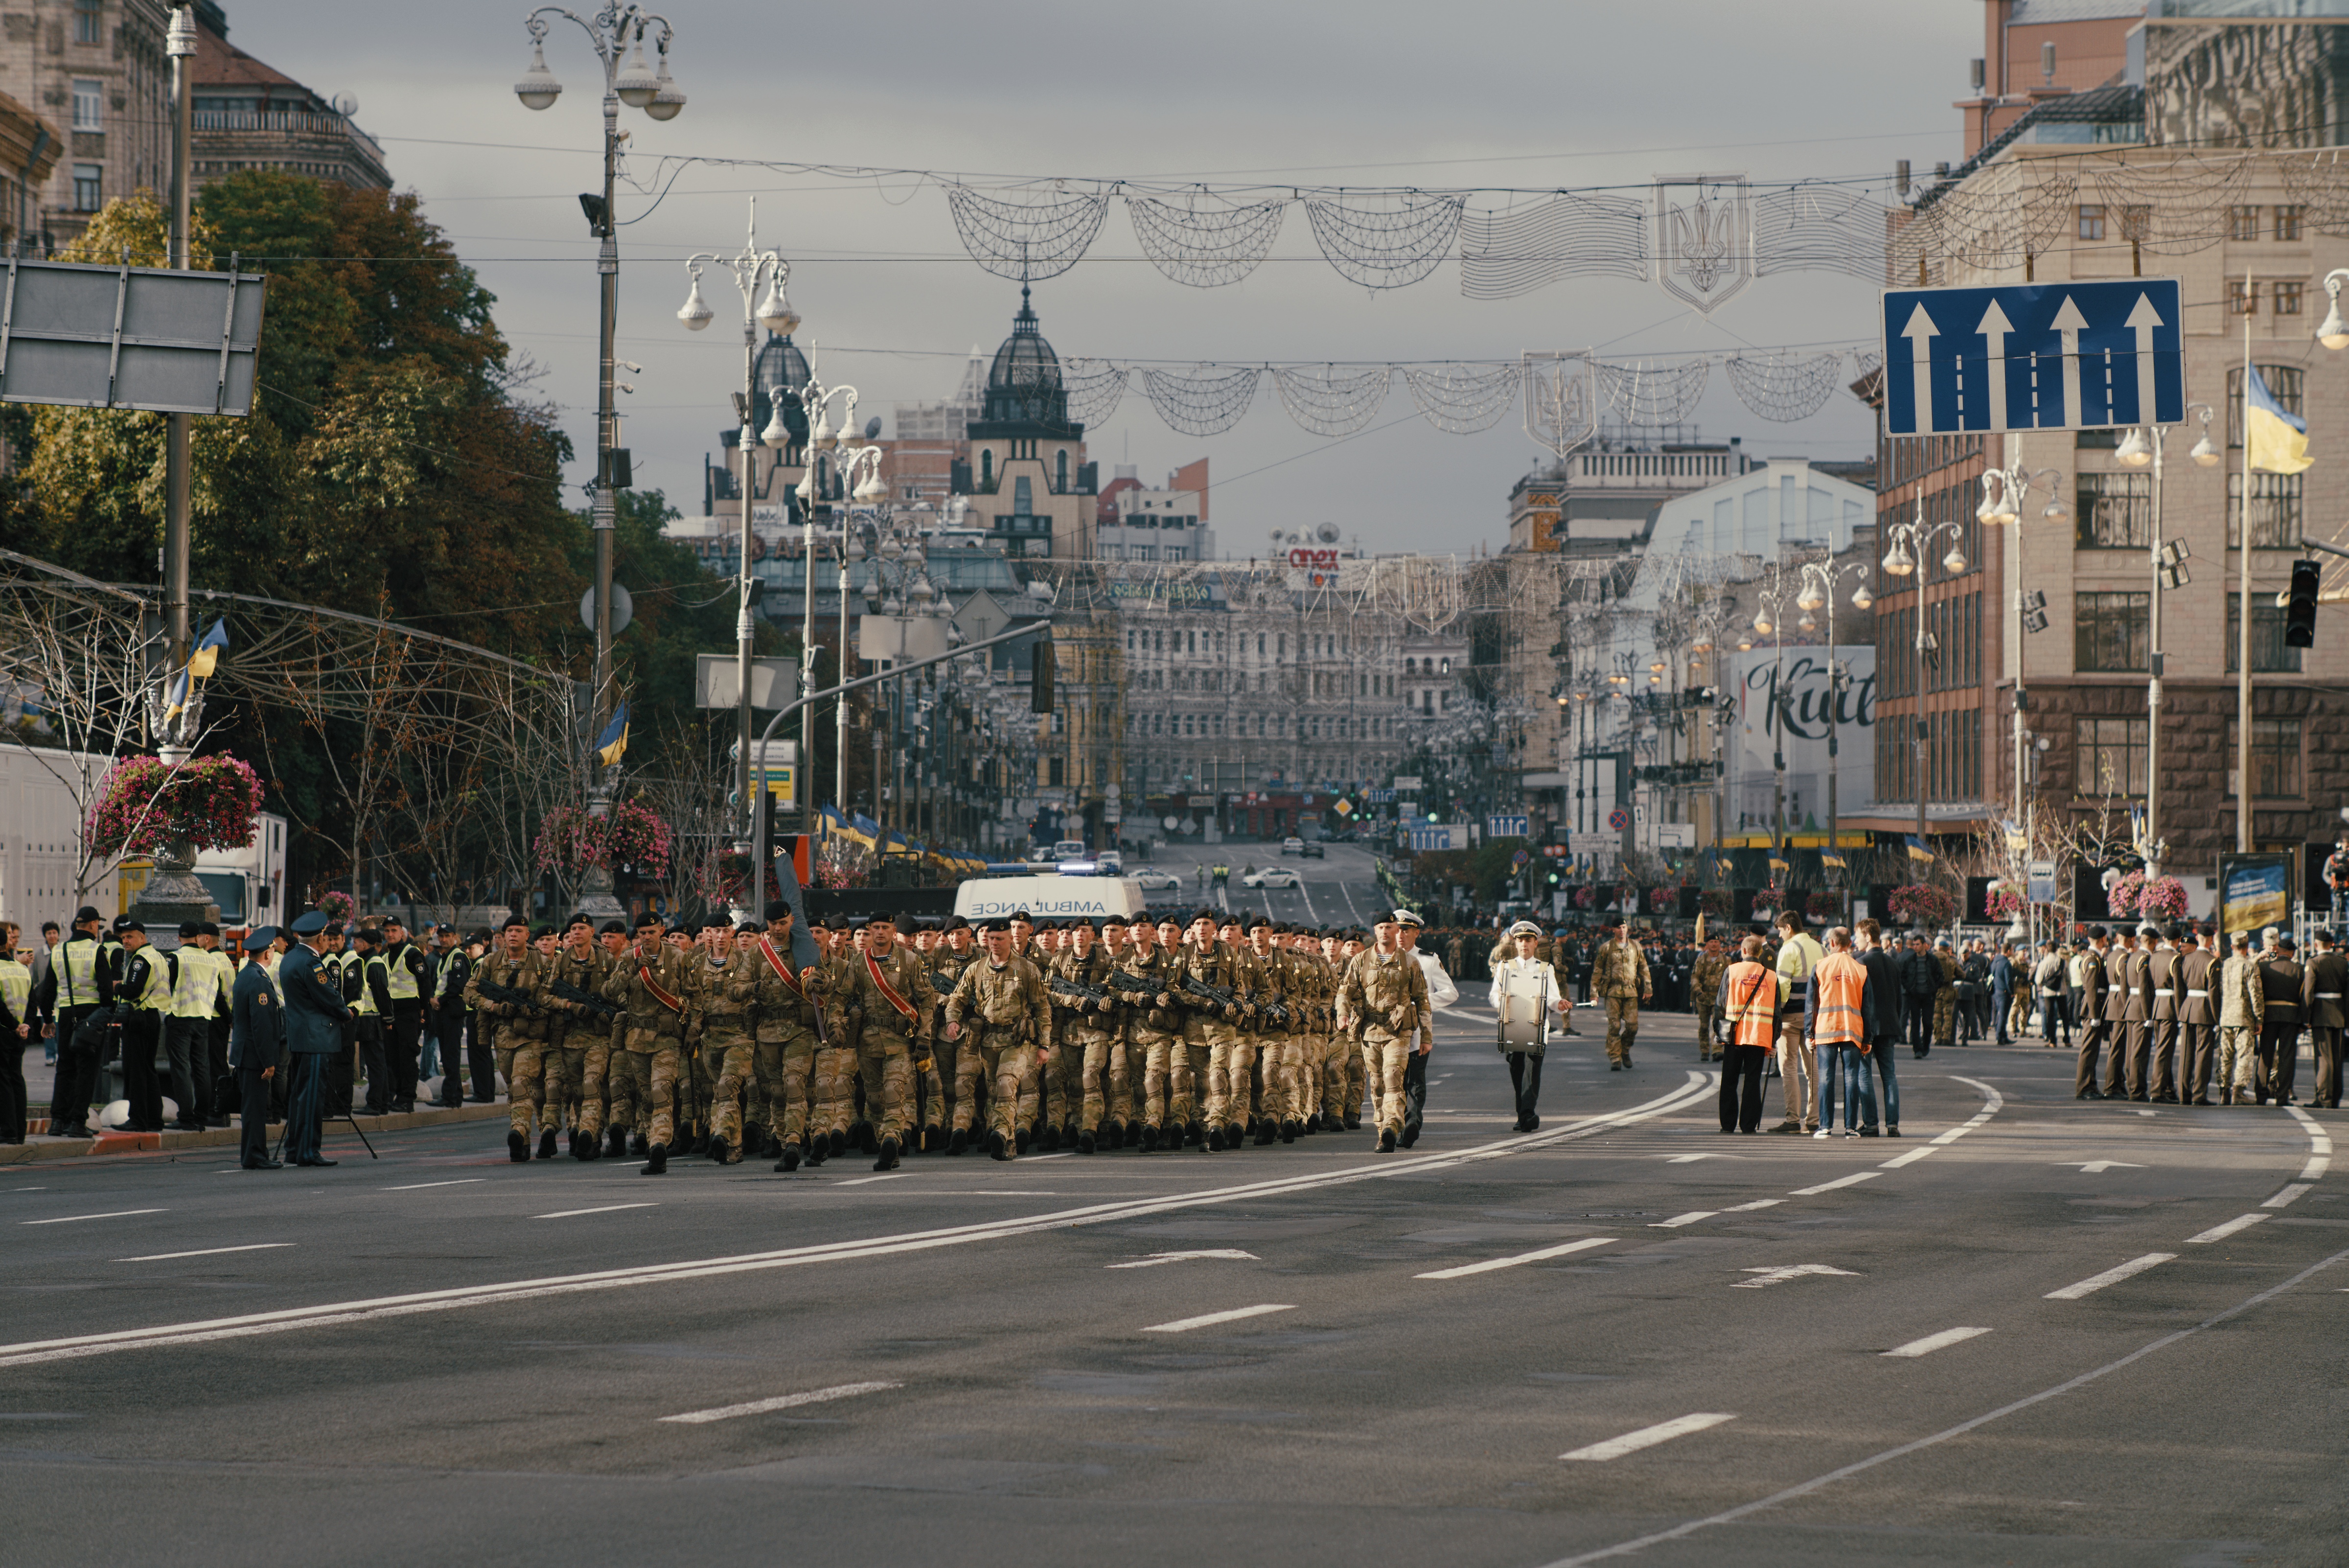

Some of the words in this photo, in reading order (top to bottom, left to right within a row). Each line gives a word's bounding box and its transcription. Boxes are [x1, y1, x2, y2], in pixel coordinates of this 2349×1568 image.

[1289, 549, 1339, 570] anex
[55, 950, 93, 959] ПЛІЦІЯ
[183, 955, 216, 966] ПОЛІЦІЯ
